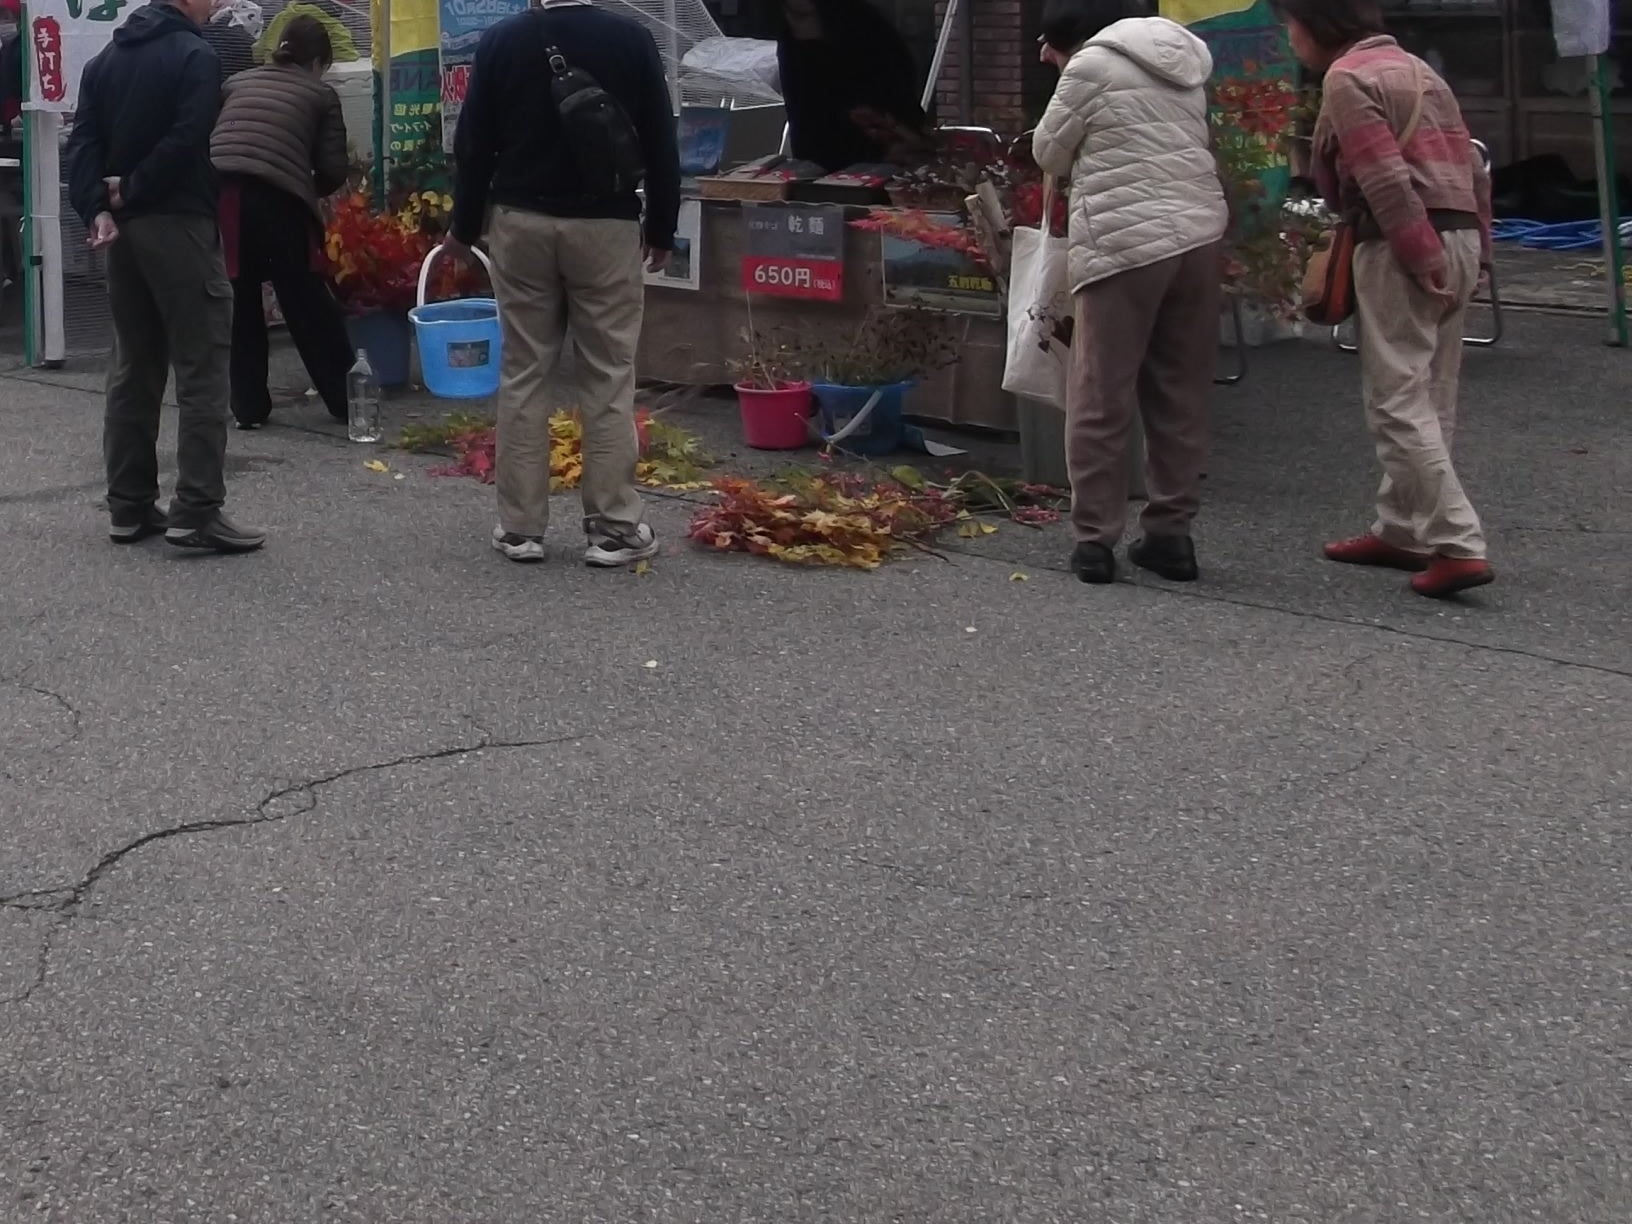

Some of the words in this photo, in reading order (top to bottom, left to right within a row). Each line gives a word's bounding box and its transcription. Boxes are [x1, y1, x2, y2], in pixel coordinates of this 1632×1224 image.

[37, 27, 57, 92] 手打ち
[754, 264, 810, 288] 650円
